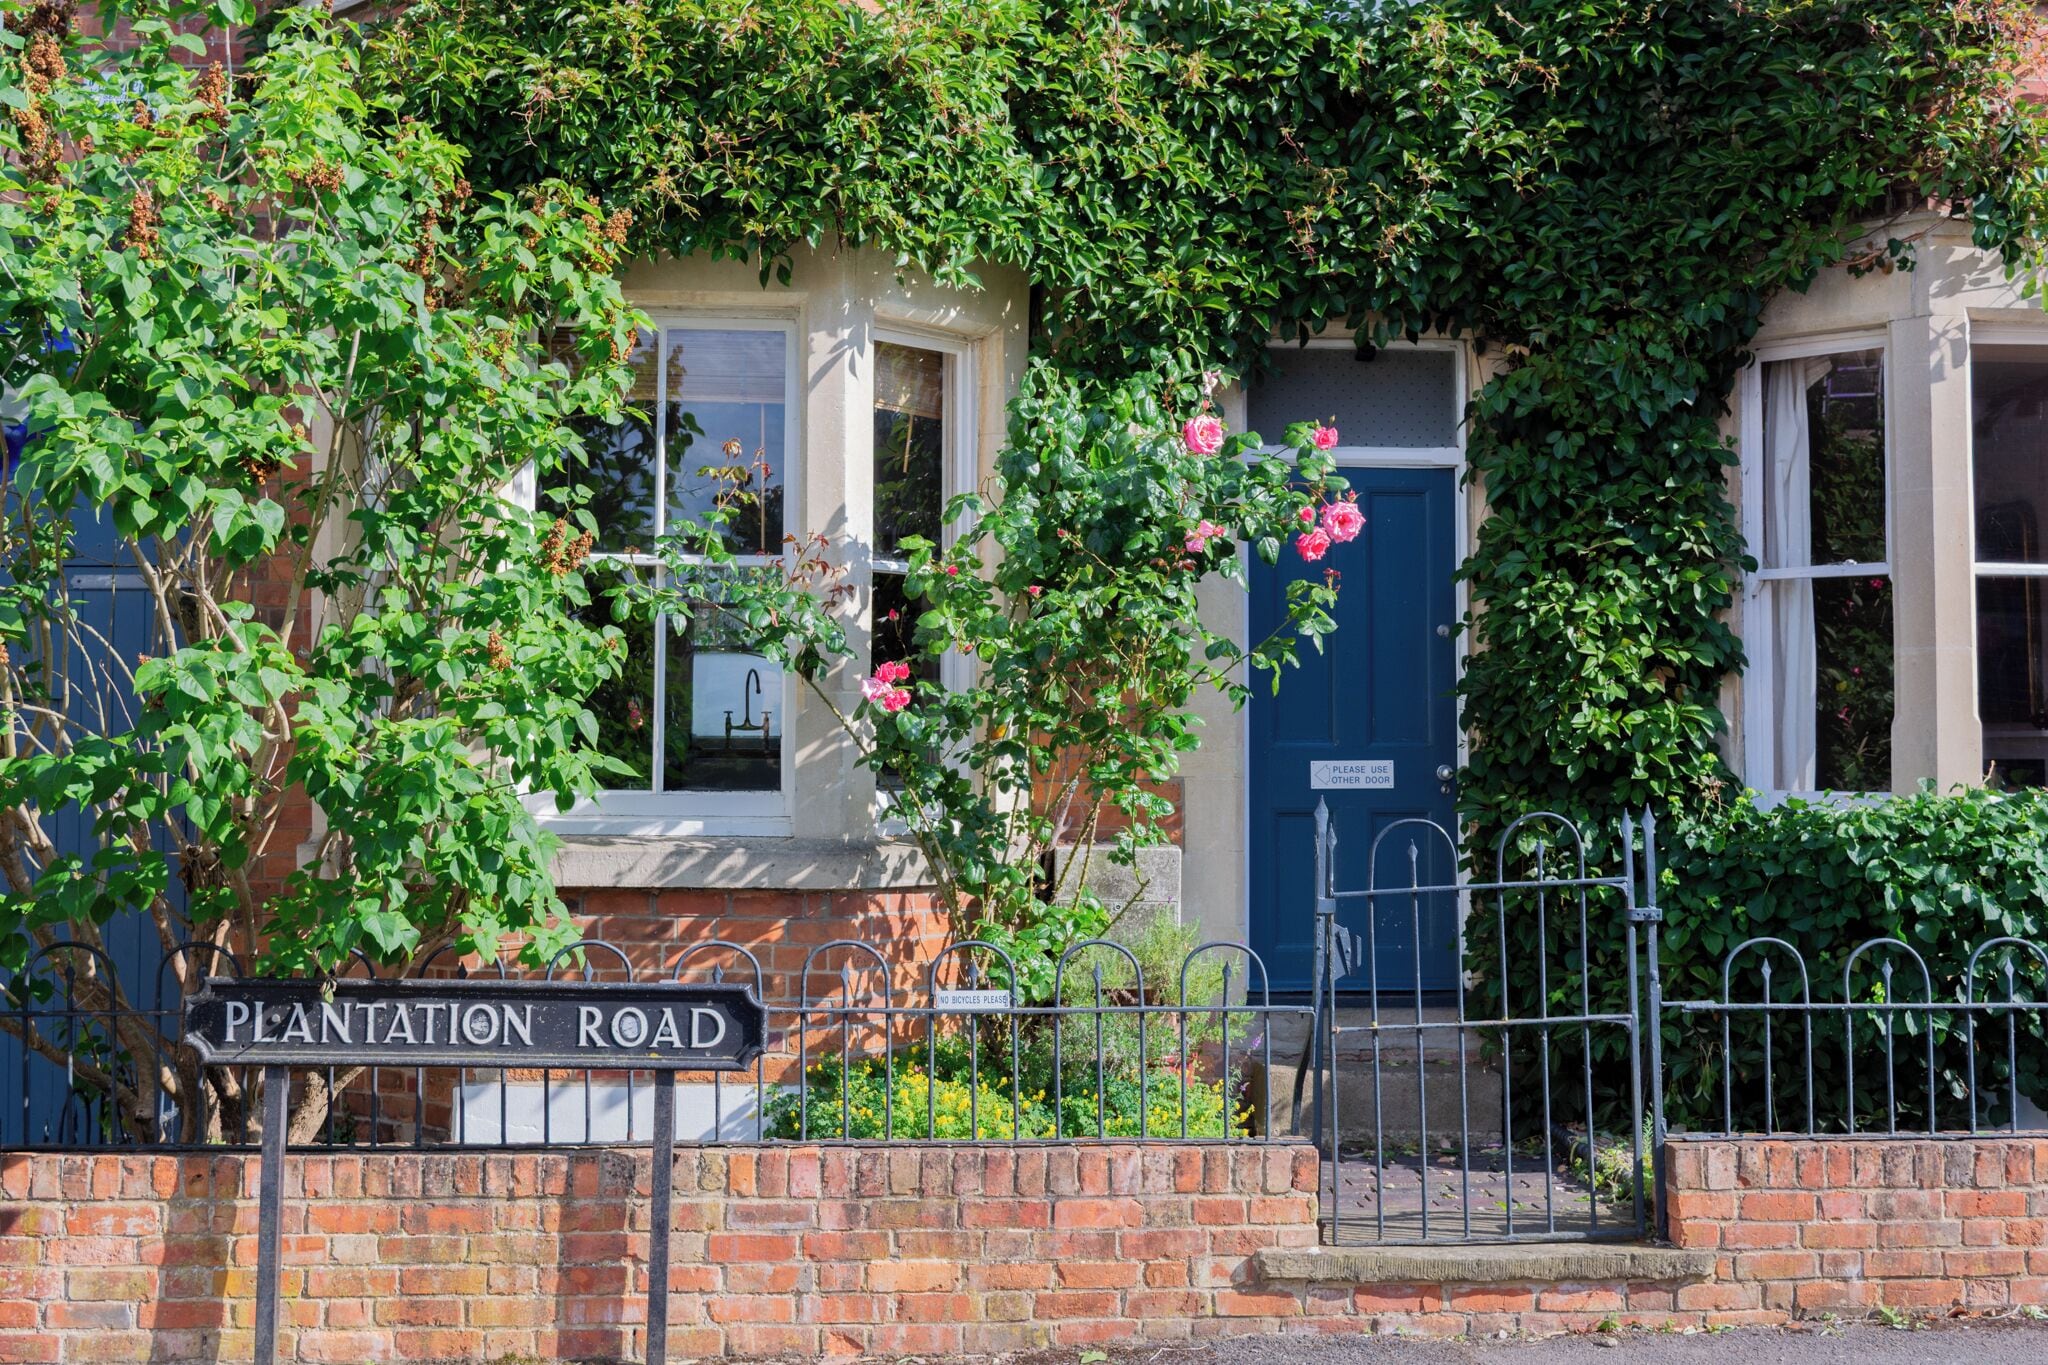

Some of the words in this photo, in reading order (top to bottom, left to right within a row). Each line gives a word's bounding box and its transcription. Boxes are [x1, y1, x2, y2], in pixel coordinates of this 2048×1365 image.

[1332, 765, 1366, 774] PLEASE
[1370, 765, 1388, 774] USE
[1331, 776, 1360, 784] OTHER
[1365, 776, 1390, 784] DOOR
[940, 995, 949, 1004] NO
[952, 995, 980, 1004] BICYCLES
[983, 995, 1007, 1004] PLEASE
[225, 1000, 534, 1046] PLANTATION
[577, 1006, 726, 1049] ROAD
